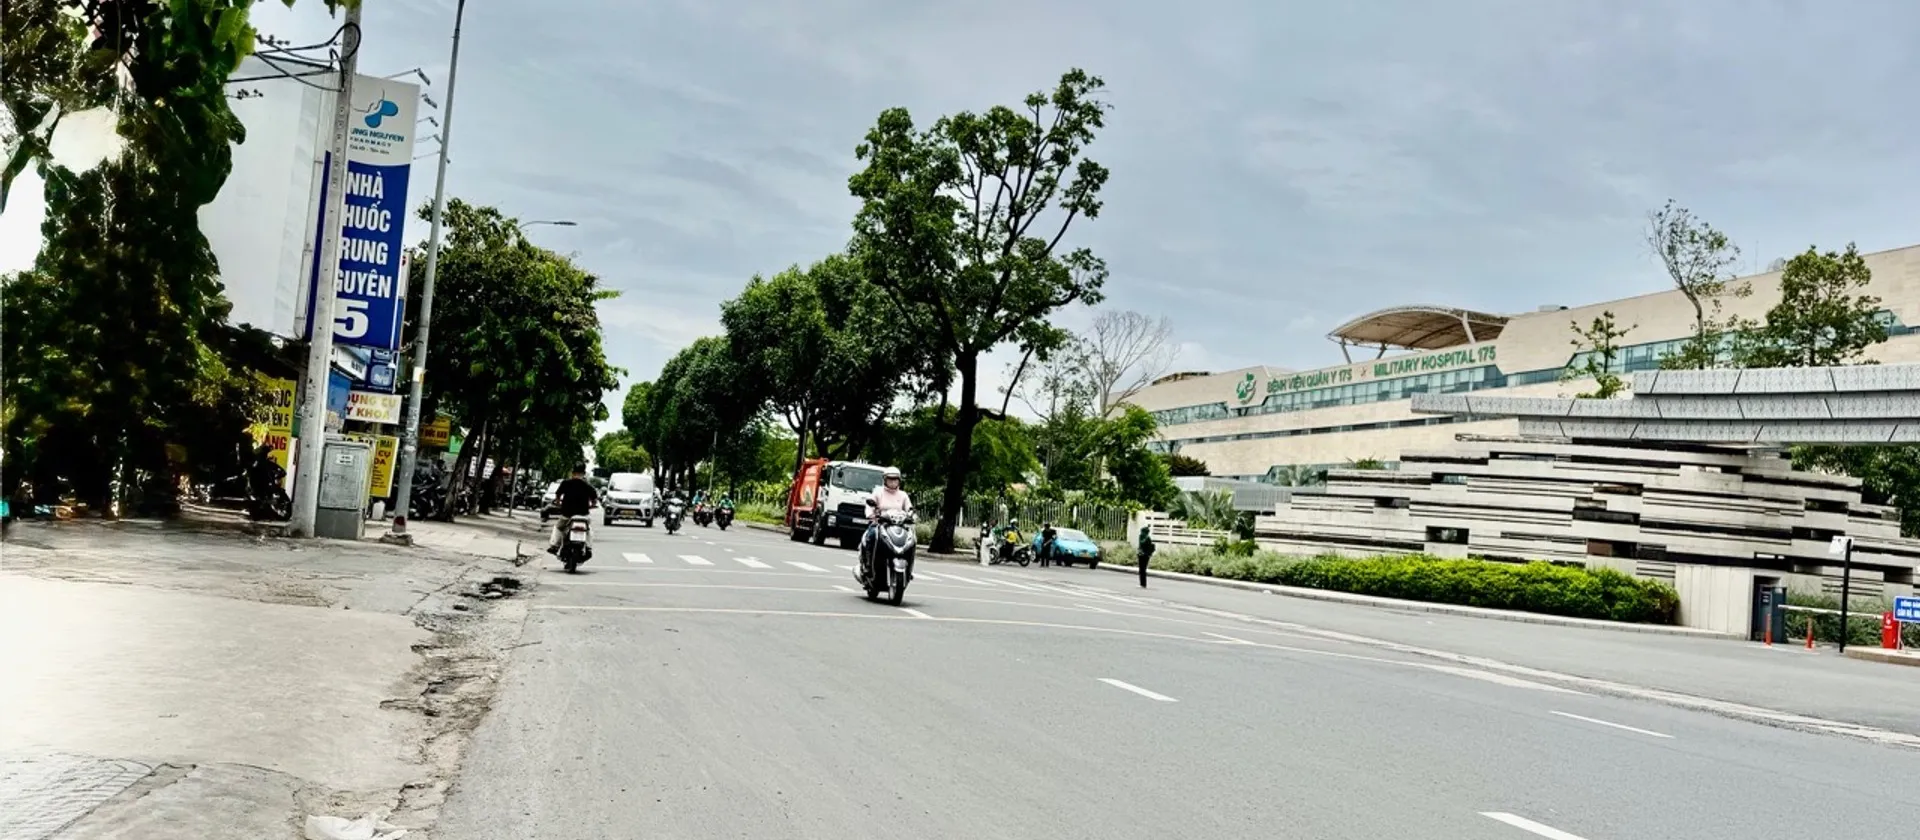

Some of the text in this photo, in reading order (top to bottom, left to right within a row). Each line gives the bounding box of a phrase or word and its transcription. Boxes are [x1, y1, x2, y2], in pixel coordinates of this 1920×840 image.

[350, 128, 368, 137] UNG
[346, 171, 383, 199] NHÀ
[343, 201, 391, 232] HUỐC
[339, 237, 388, 265] RUNG
[336, 269, 392, 298] GUYÊN
[333, 300, 369, 338] 5
[1374, 345, 1496, 377] MILITARY HOSPITAL 175
[1330, 371, 1337, 384] Y
[1339, 368, 1353, 382] 175
[346, 406, 354, 416] Y
